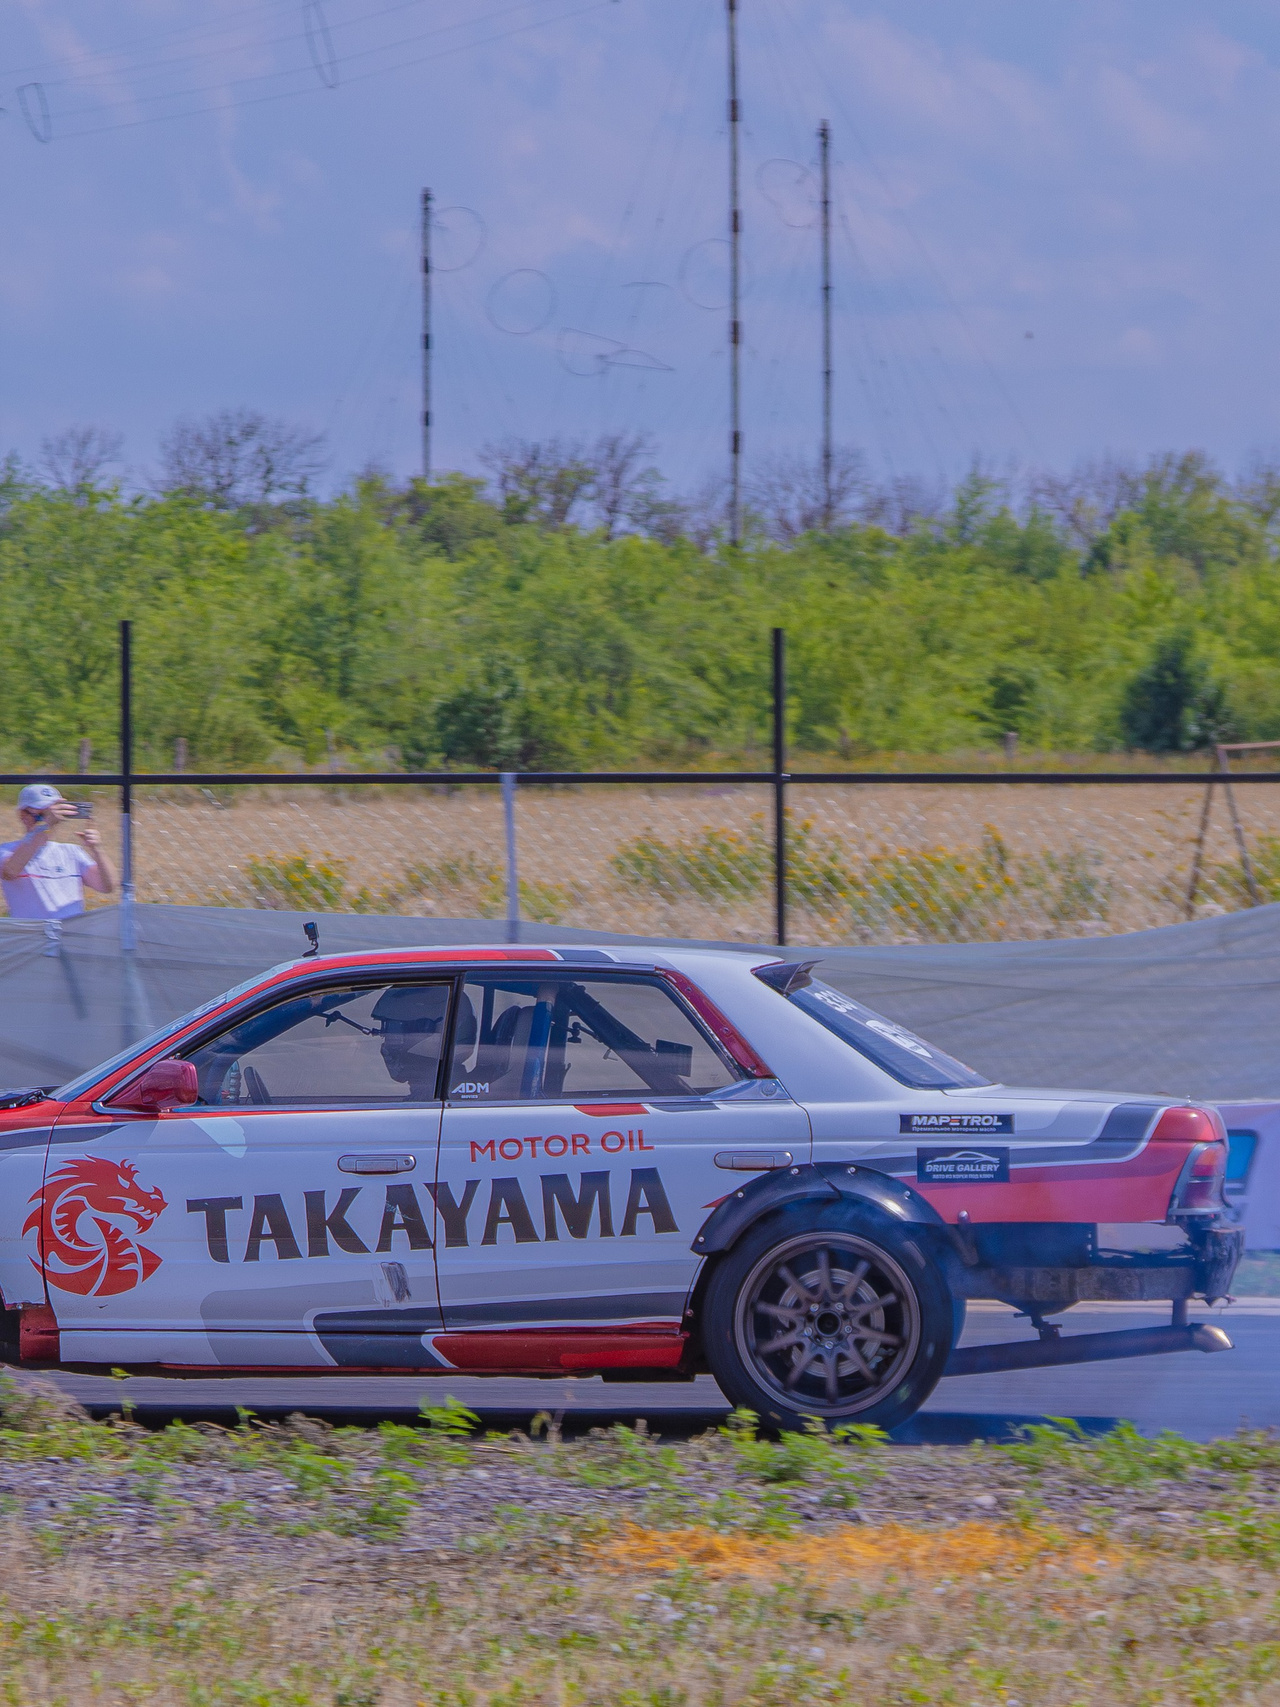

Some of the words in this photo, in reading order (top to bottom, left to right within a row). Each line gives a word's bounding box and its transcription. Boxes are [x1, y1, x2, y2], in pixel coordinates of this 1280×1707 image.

[451, 1082, 489, 1094] ADM
[912, 1115, 1002, 1126] MAPETROL
[470, 1133, 592, 1163] MOTOR
[601, 1129, 655, 1153] OIL
[925, 1164, 955, 1173] DRIVE
[957, 1164, 1000, 1172] GALLERY
[186, 1166, 681, 1264] TAKAYAMA
